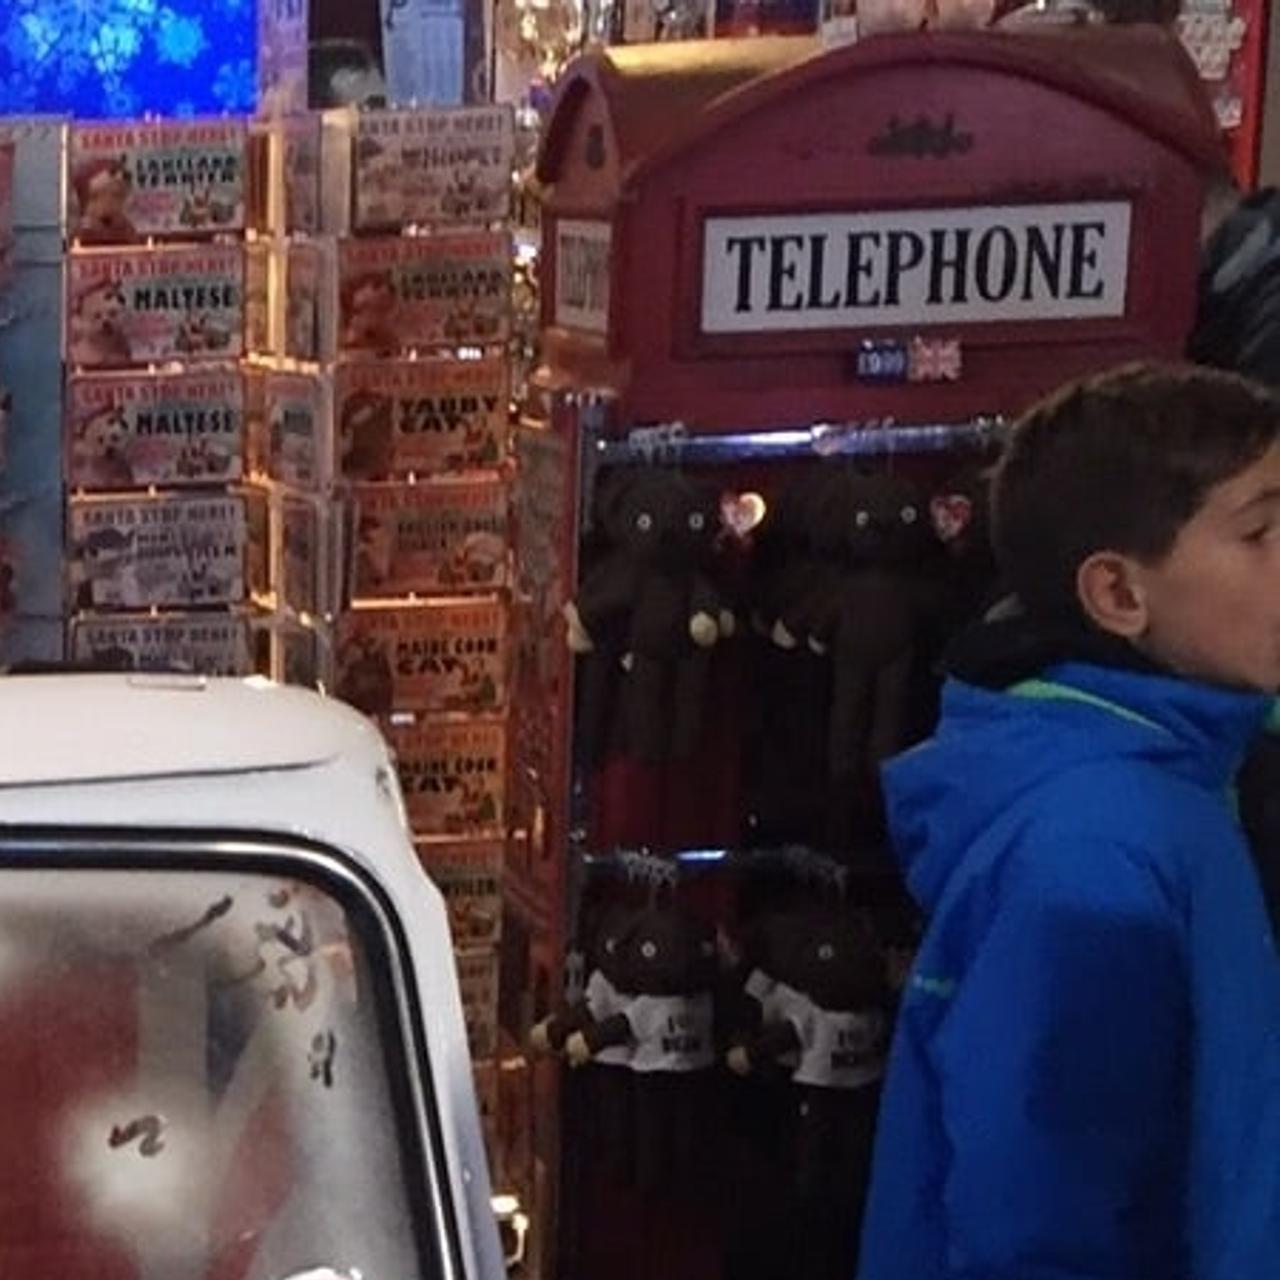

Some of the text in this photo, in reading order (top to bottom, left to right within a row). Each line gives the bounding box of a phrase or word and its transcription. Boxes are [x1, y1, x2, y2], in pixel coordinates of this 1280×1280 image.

[726, 221, 1106, 314] TELEPHONE
[133, 284, 234, 311] MALTESE
[135, 408, 234, 435] MALTESE
